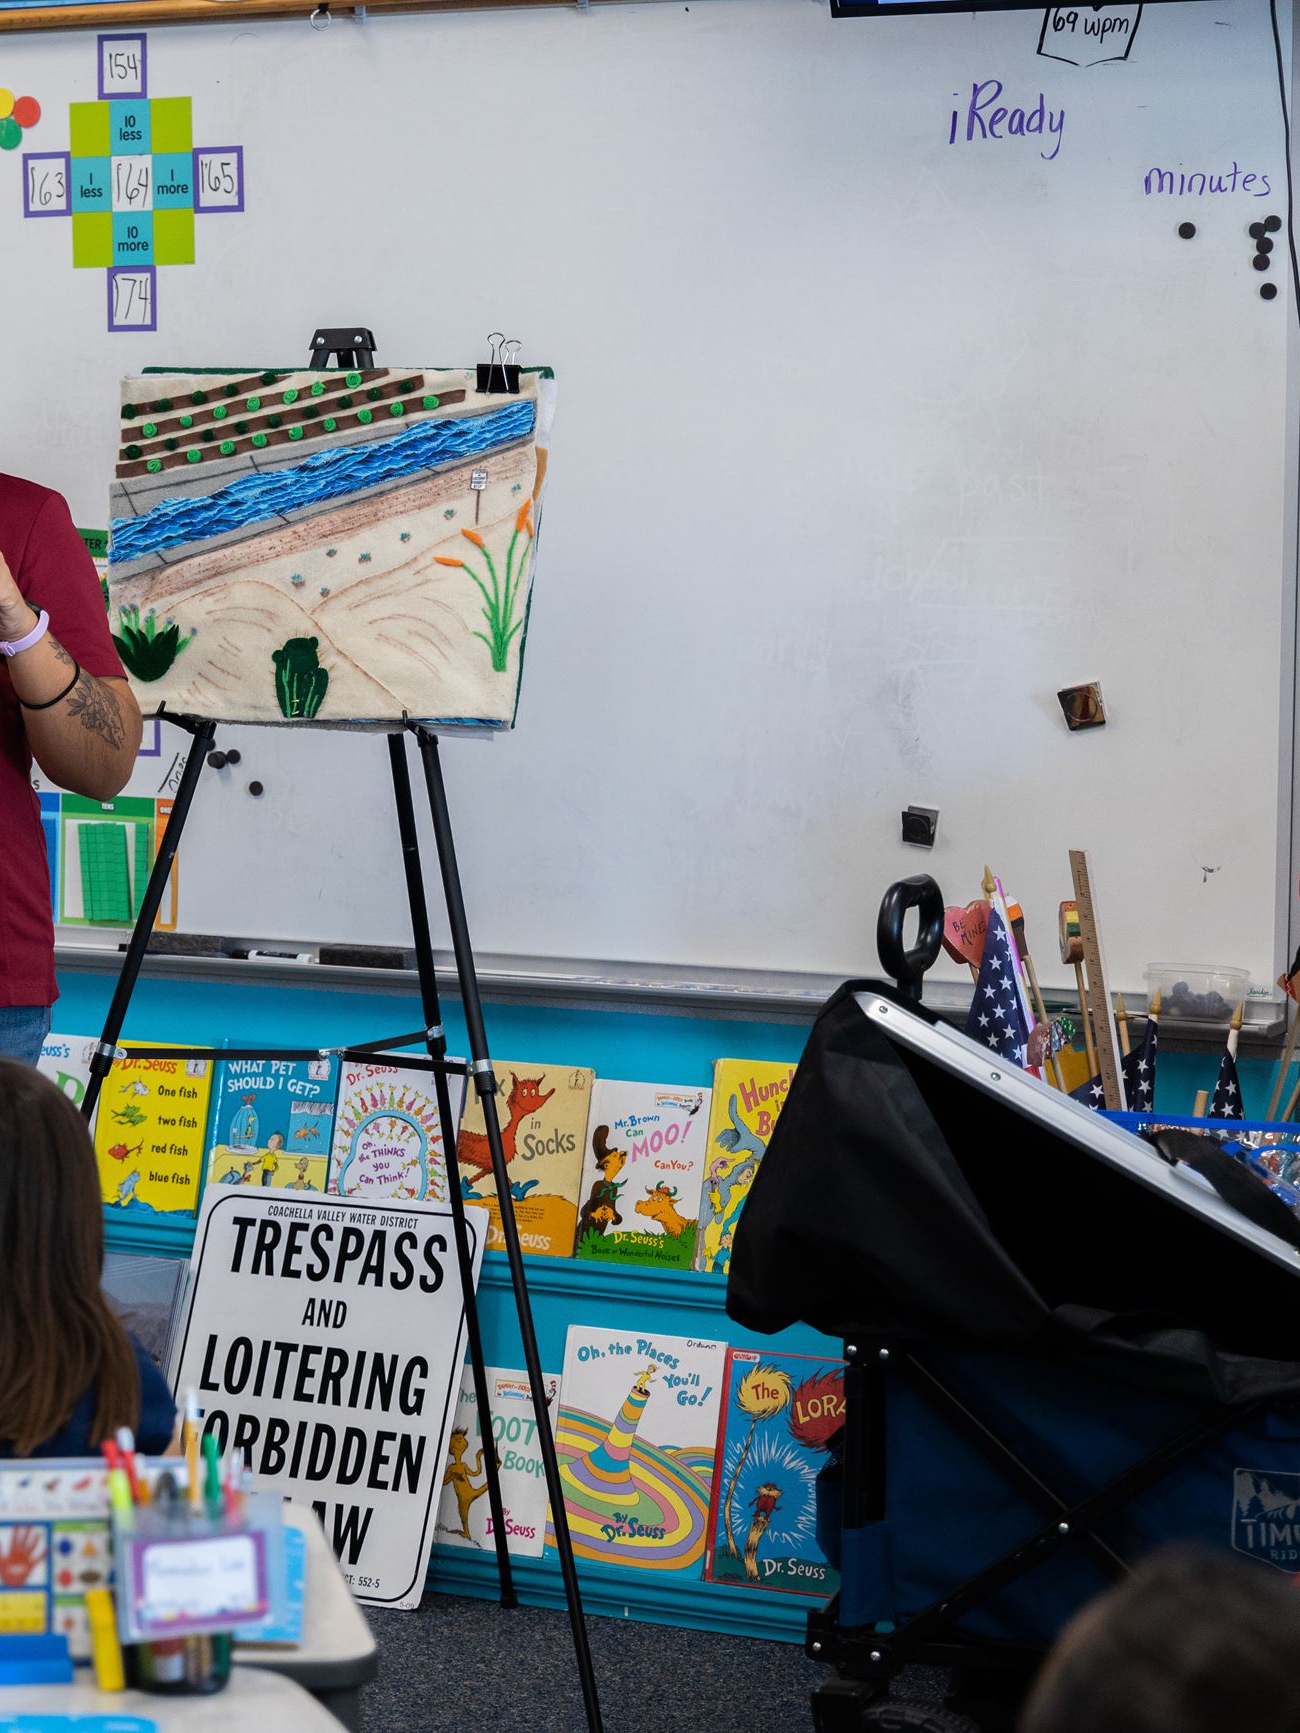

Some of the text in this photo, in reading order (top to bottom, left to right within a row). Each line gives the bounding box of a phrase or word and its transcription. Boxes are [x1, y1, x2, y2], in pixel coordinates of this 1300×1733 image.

[1052, 7, 1129, 45] 69 wpm
[108, 53, 140, 81] 154
[125, 115, 136, 128] 10
[948, 79, 1066, 160] iReady
[120, 128, 142, 140] less
[89, 173, 93, 185] 1
[170, 169, 175, 181] 1
[200, 158, 235, 194] 165
[1143, 161, 1272, 197] minutes
[30, 166, 66, 206] 163
[81, 185, 103, 198] less
[116, 161, 150, 208] 164
[157, 184, 188, 194] more
[128, 226, 138, 238] 10
[118, 241, 148, 252] more
[112, 272, 150, 324] 174
[226, 1059, 297, 1077] WHAT PET
[227, 1076, 275, 1092] SHOULD
[287, 1081, 321, 1098] GET?
[346, 1070, 365, 1087] Dr.
[158, 1085, 197, 1098] One fish
[158, 1116, 197, 1128] two fish
[530, 1117, 541, 1130] in
[614, 1114, 660, 1129] Mr. Brown
[626, 1128, 644, 1138] Can
[630, 1120, 693, 1163] MOO!
[152, 1144, 188, 1156] red fish
[371, 1147, 405, 1159] THINKS
[520, 1129, 576, 1161] Socks
[373, 1160, 390, 1171] you
[654, 1160, 694, 1172] Can You?
[149, 1171, 190, 1185] blue fish
[358, 1166, 410, 1184] Can Think!
[267, 1205, 418, 1231] COACHELLA VALLEY WATER DISTRICT
[613, 1231, 665, 1248] Dr. Seuss's
[230, 1216, 448, 1294] TRESPASS
[591, 1244, 609, 1255] Book
[302, 1298, 347, 1328] AND
[577, 1339, 680, 1369] Oh, the Places
[199, 1333, 429, 1417] LOITERING
[663, 1373, 700, 1389] You'll
[677, 1387, 713, 1407] Go!
[751, 1384, 780, 1401] The
[600, 1518, 666, 1543] Dr. Seuss
[762, 1558, 827, 1581] Dr. Seuss
[358, 1577, 380, 1588] 552-5
